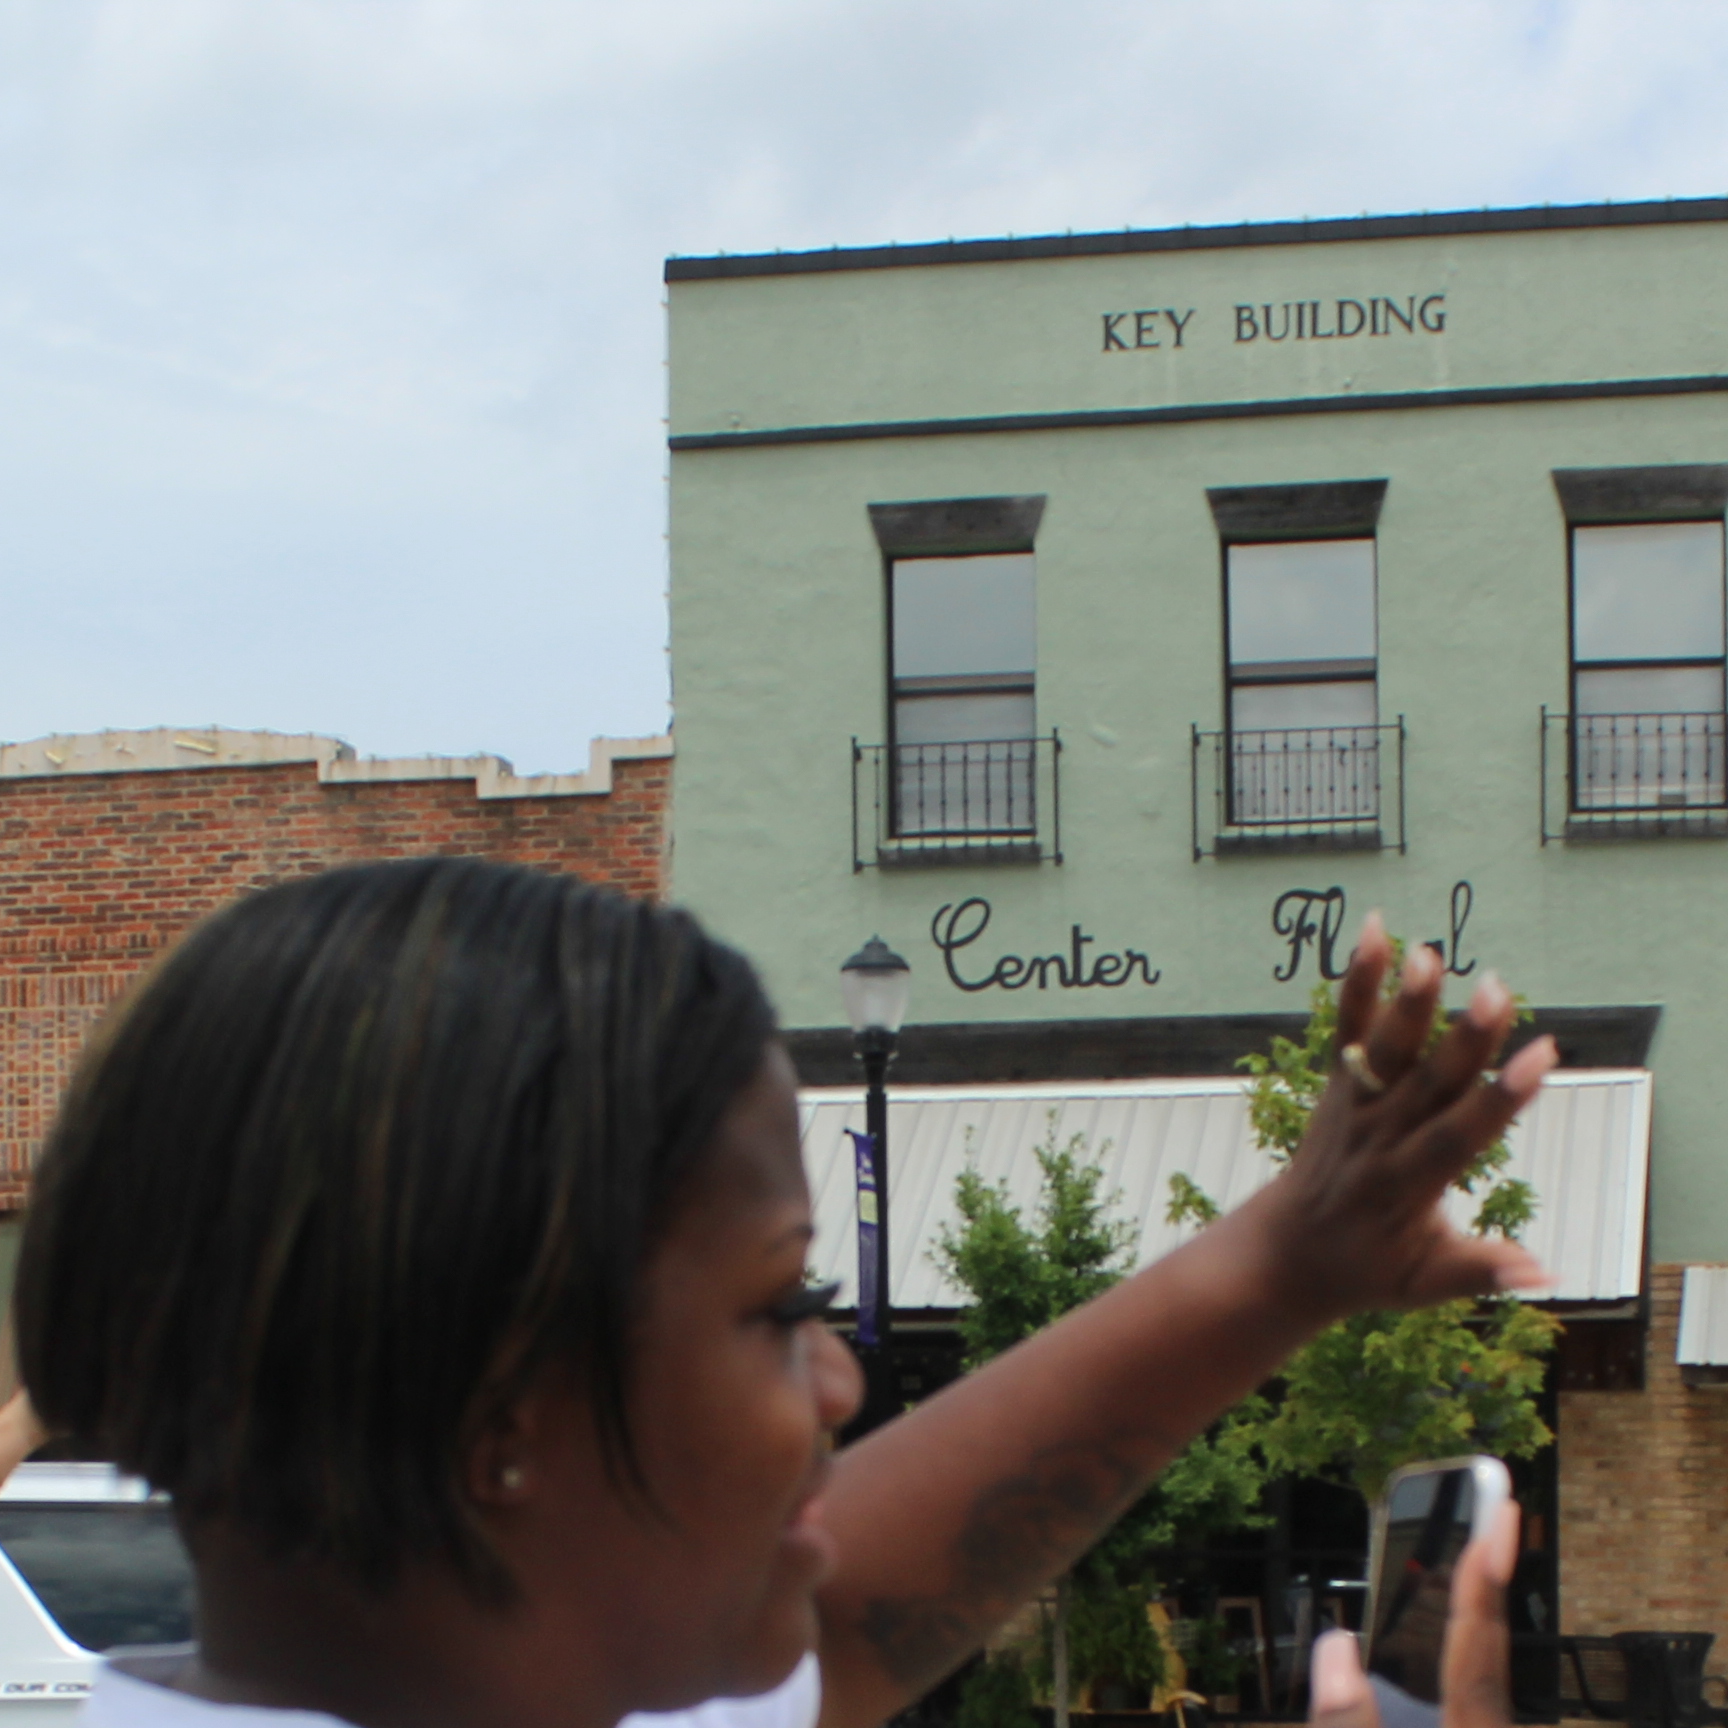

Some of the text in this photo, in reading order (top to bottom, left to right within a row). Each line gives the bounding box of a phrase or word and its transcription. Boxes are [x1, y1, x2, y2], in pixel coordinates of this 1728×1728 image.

[1101, 293, 1448, 352] KEY BUILDING
[930, 880, 1478, 993] Center Fll
